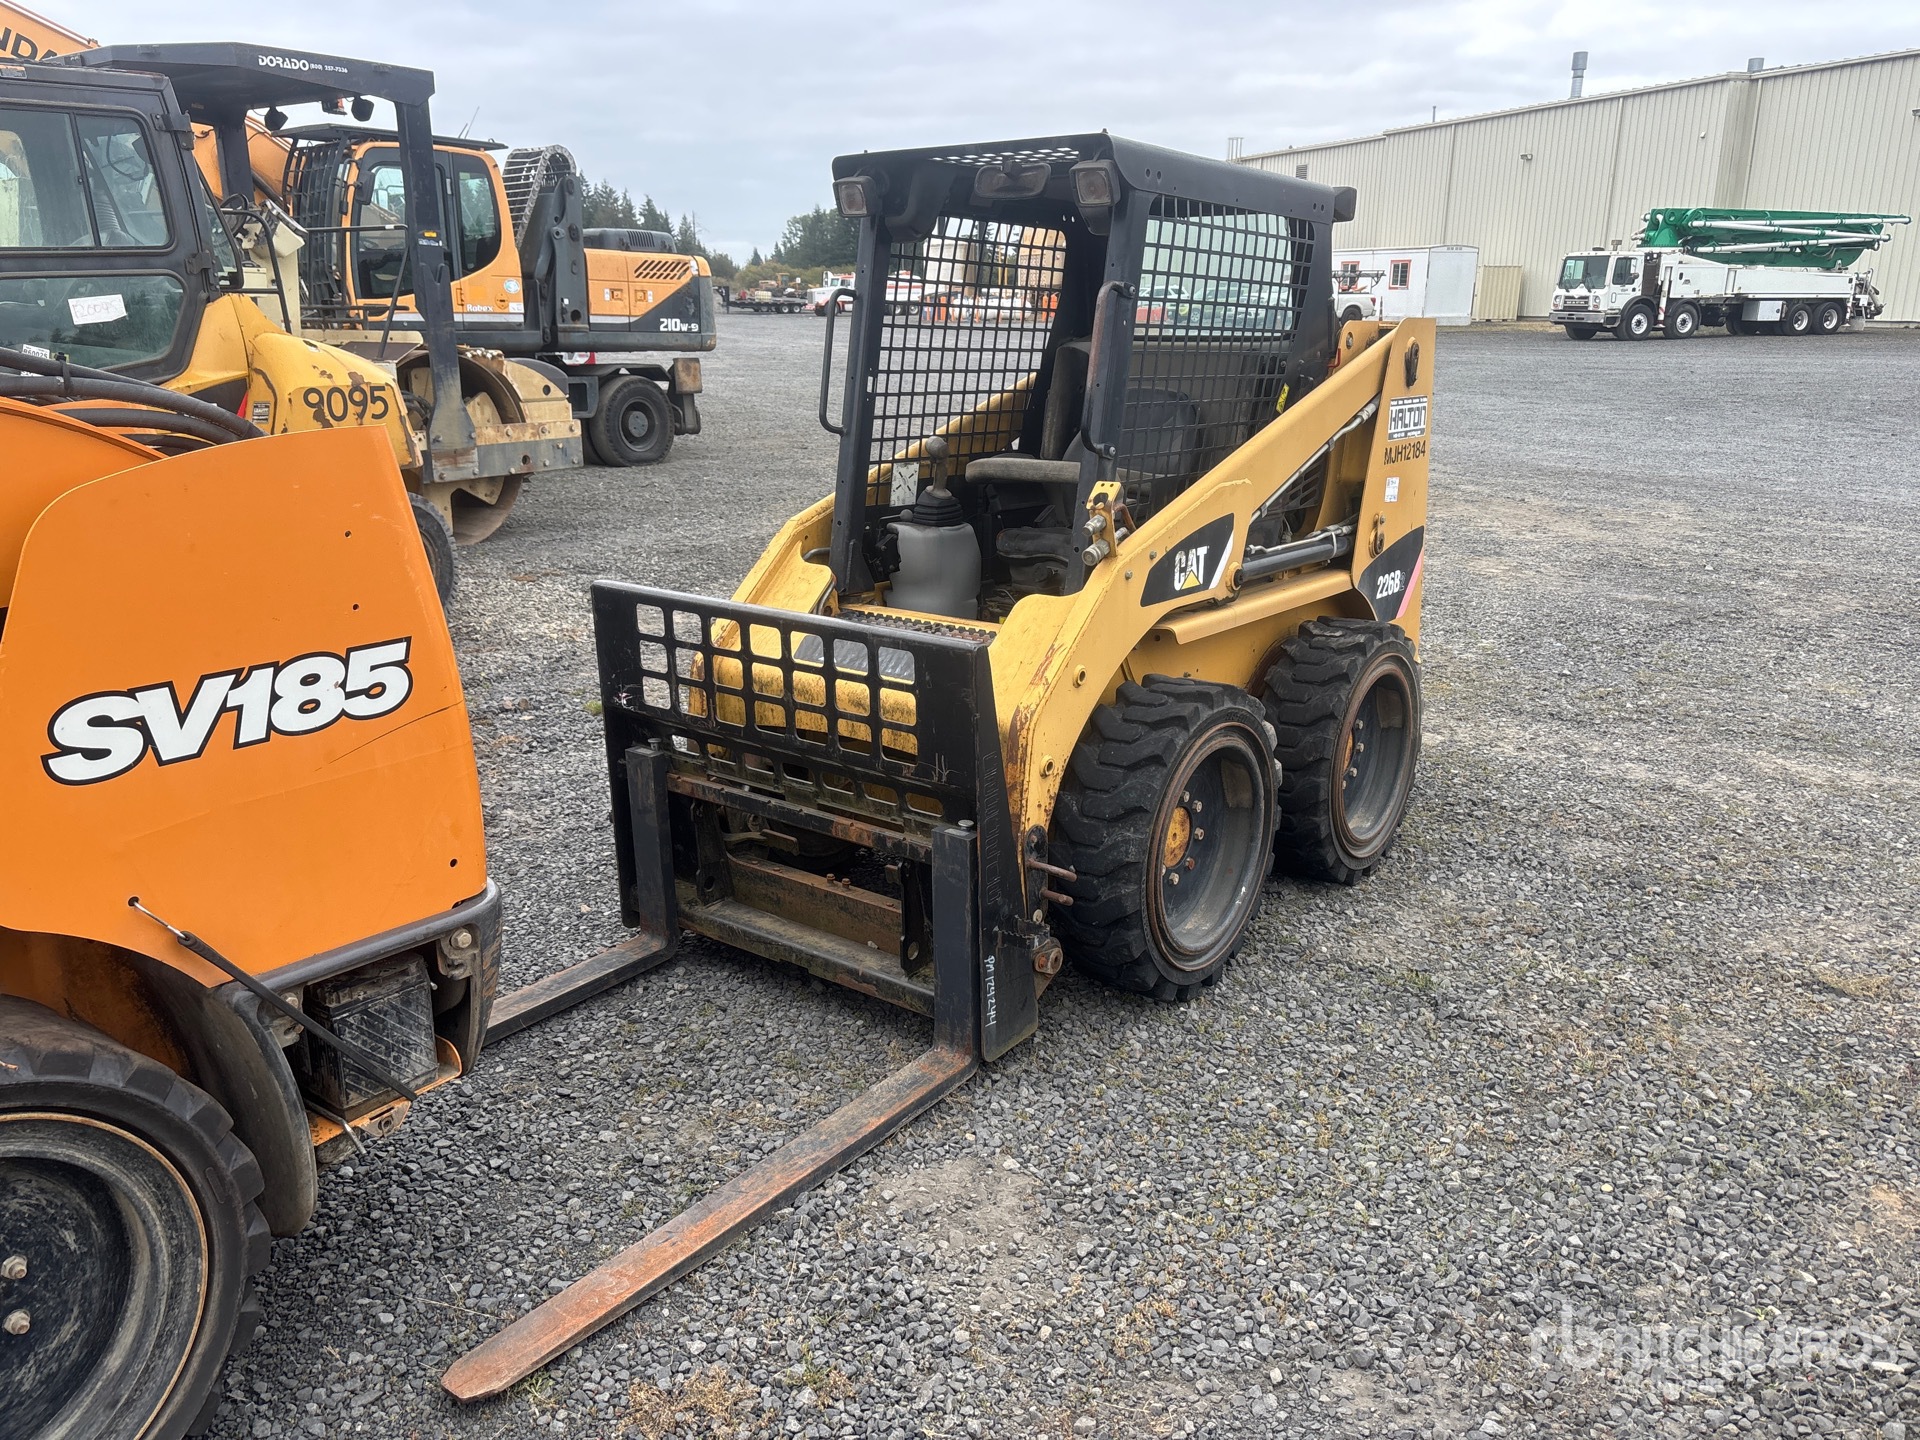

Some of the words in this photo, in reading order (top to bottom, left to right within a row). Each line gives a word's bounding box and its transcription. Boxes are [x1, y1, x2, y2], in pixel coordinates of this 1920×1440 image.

[258, 55, 310, 71] DORADO
[303, 385, 389, 423] 9095
[1389, 405, 1427, 431] HALTON
[1383, 440, 1427, 466] MJH12184
[1173, 545, 1206, 591] CAT
[40, 635, 413, 787] SV185
